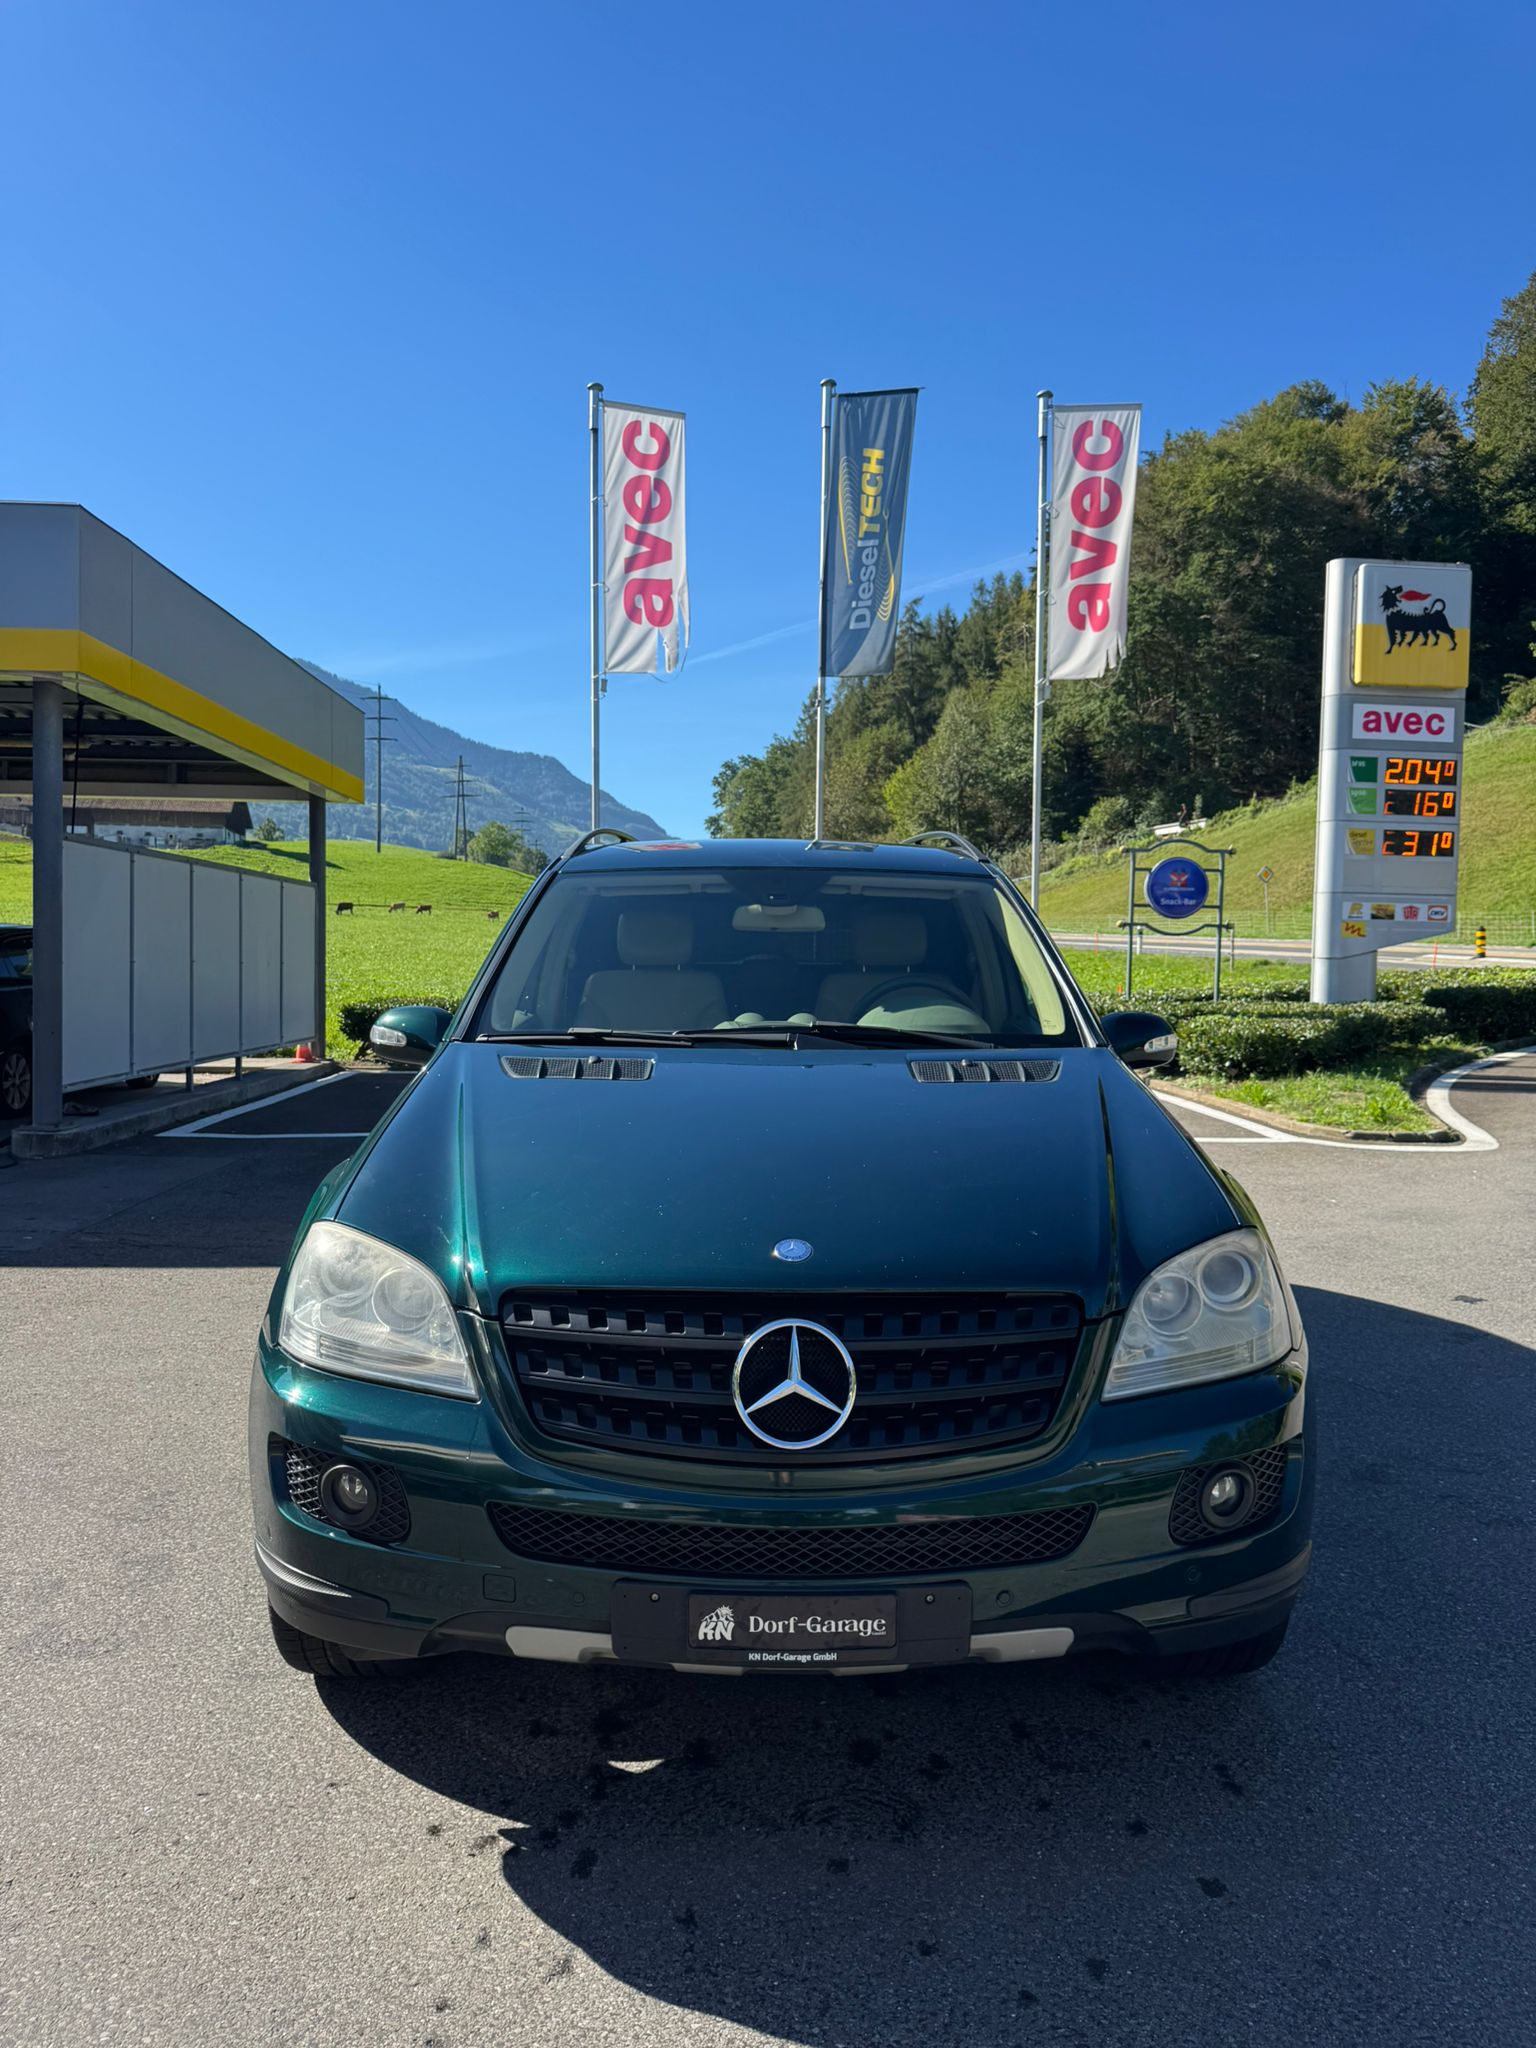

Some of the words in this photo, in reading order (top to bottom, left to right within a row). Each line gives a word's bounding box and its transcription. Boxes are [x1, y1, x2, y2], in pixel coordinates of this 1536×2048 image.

[622, 419, 674, 628] avec
[1067, 419, 1124, 633] avec
[1362, 710, 1445, 736] avec
[749, 1616, 886, 1636] Dorf-Garage
[748, 1652, 761, 1661] KN
[762, 1652, 812, 1663] Dorf-Garage
[813, 1652, 837, 1661] GmbH
